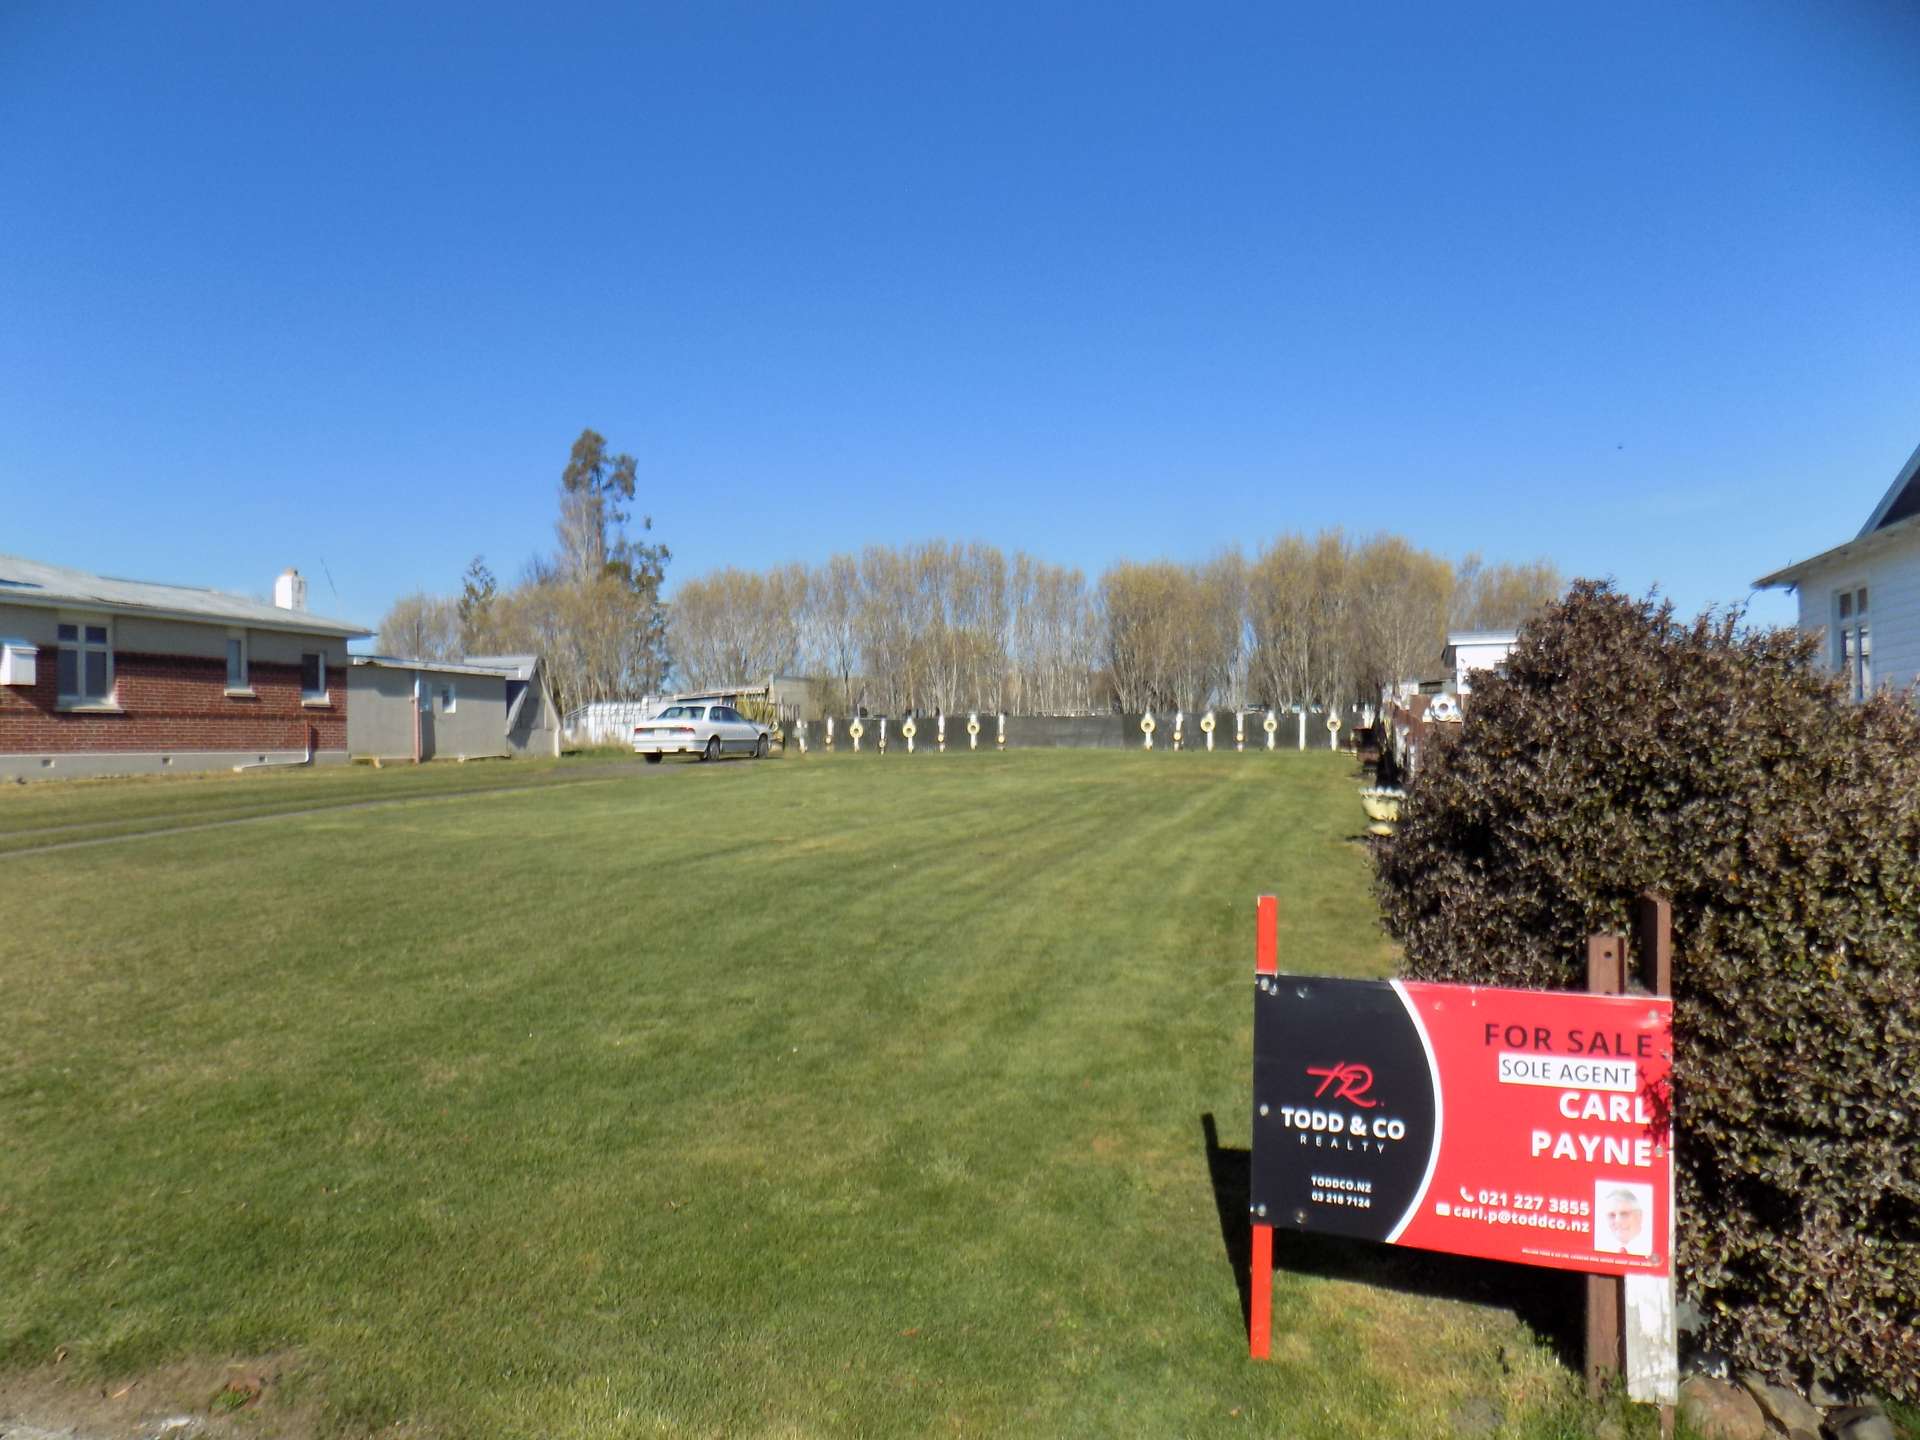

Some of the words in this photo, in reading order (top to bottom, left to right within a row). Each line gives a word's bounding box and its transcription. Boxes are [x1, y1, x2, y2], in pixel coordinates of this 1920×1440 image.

[1484, 1023, 1552, 1052] FOR
[1567, 1029, 1653, 1059] SALE
[1501, 1058, 1551, 1080] SOLE
[1559, 1063, 1631, 1086] AGENT
[1559, 1090, 1652, 1126] CARL
[1281, 1106, 1345, 1134] TODD
[1349, 1114, 1368, 1137] &
[1372, 1117, 1406, 1141] CO
[1299, 1133, 1385, 1155] REALTY
[1531, 1129, 1653, 1168] PAYNE
[1311, 1174, 1372, 1194] TODDCO.NZ
[1311, 1189, 1325, 1203] 03
[1478, 1188, 1509, 1207] 021
[1512, 1192, 1544, 1211] 227
[1548, 1196, 1591, 1217] 3855
[1453, 1204, 1591, 1234] carl.p@toddco.nz
